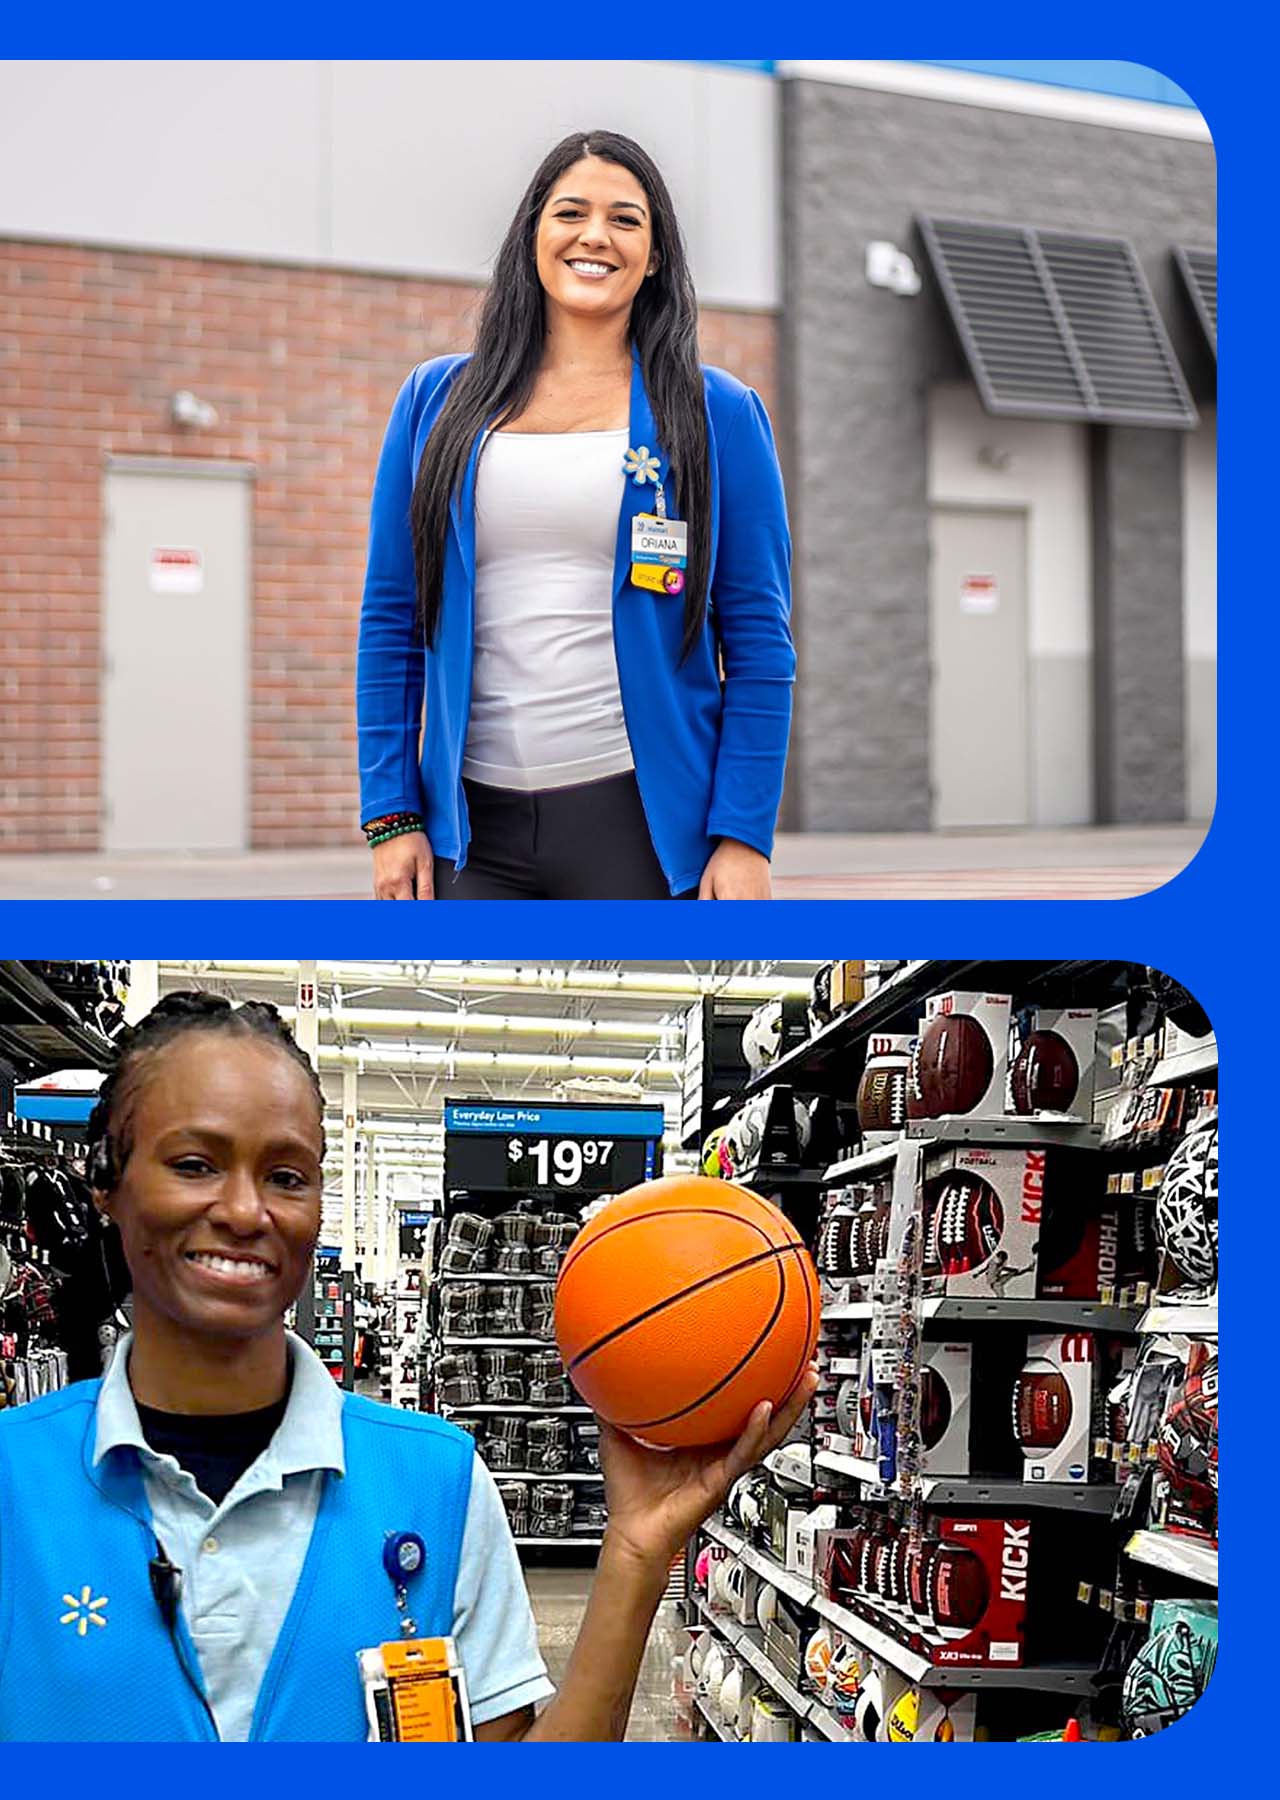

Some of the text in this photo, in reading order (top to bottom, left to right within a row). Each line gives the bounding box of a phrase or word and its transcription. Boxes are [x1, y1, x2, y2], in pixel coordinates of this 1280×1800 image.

[641, 537, 678, 550] ORIANA
[453, 1108, 541, 1122] Everyday Low Price
[1021, 1150, 1046, 1224] KICK
[1000, 1521, 1030, 1601] KICK
